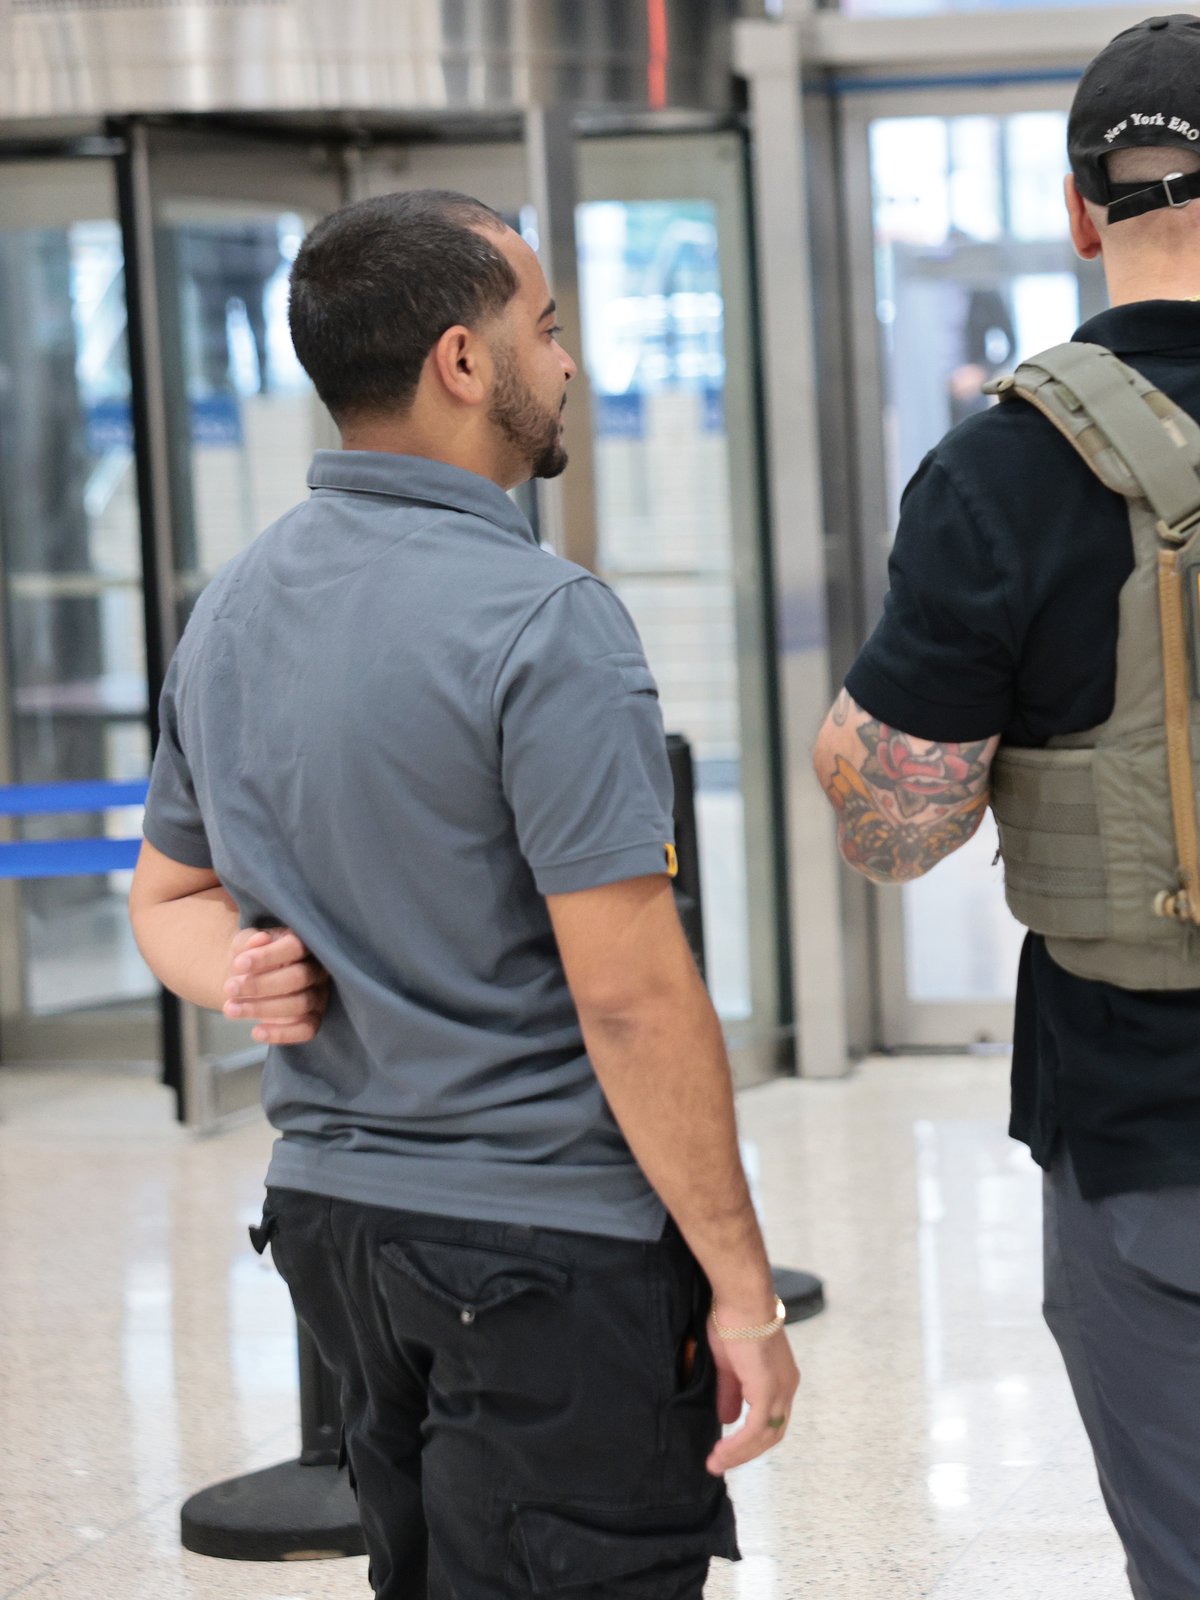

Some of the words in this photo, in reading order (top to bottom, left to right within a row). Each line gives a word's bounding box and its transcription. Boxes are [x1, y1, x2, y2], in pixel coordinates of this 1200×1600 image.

[1103, 120, 1128, 143] New
[1130, 113, 1165, 126] York
[1167, 116, 1200, 141] ERO
